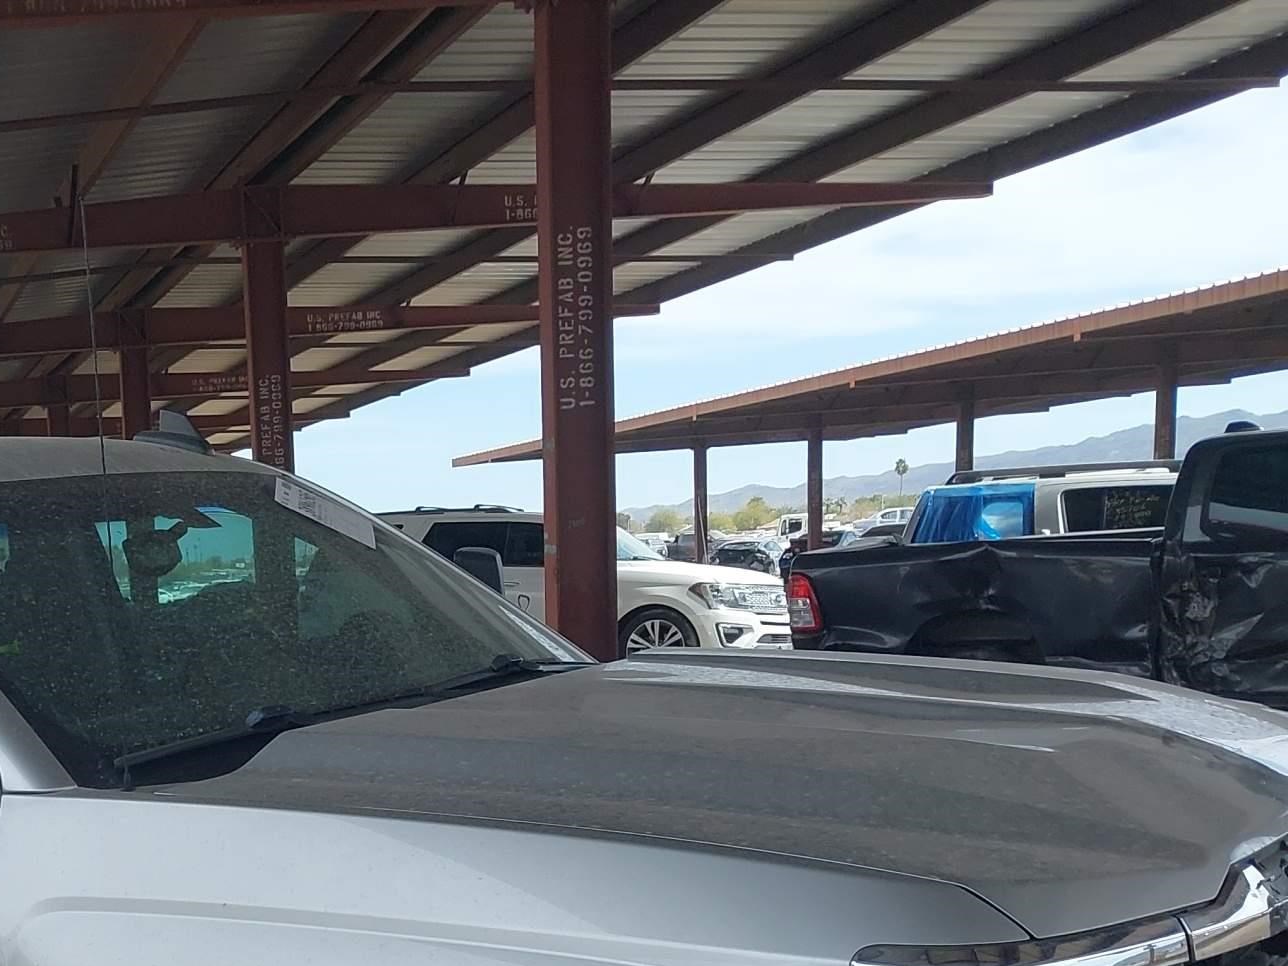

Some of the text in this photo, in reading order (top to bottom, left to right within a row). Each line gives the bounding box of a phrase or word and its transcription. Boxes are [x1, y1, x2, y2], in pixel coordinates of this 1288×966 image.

[504, 194, 527, 207] U.S.
[557, 226, 576, 409] U.S. PREFAB INC.
[577, 226, 596, 407] 1-866-799-0969
[259, 406, 272, 456] PREFAB
